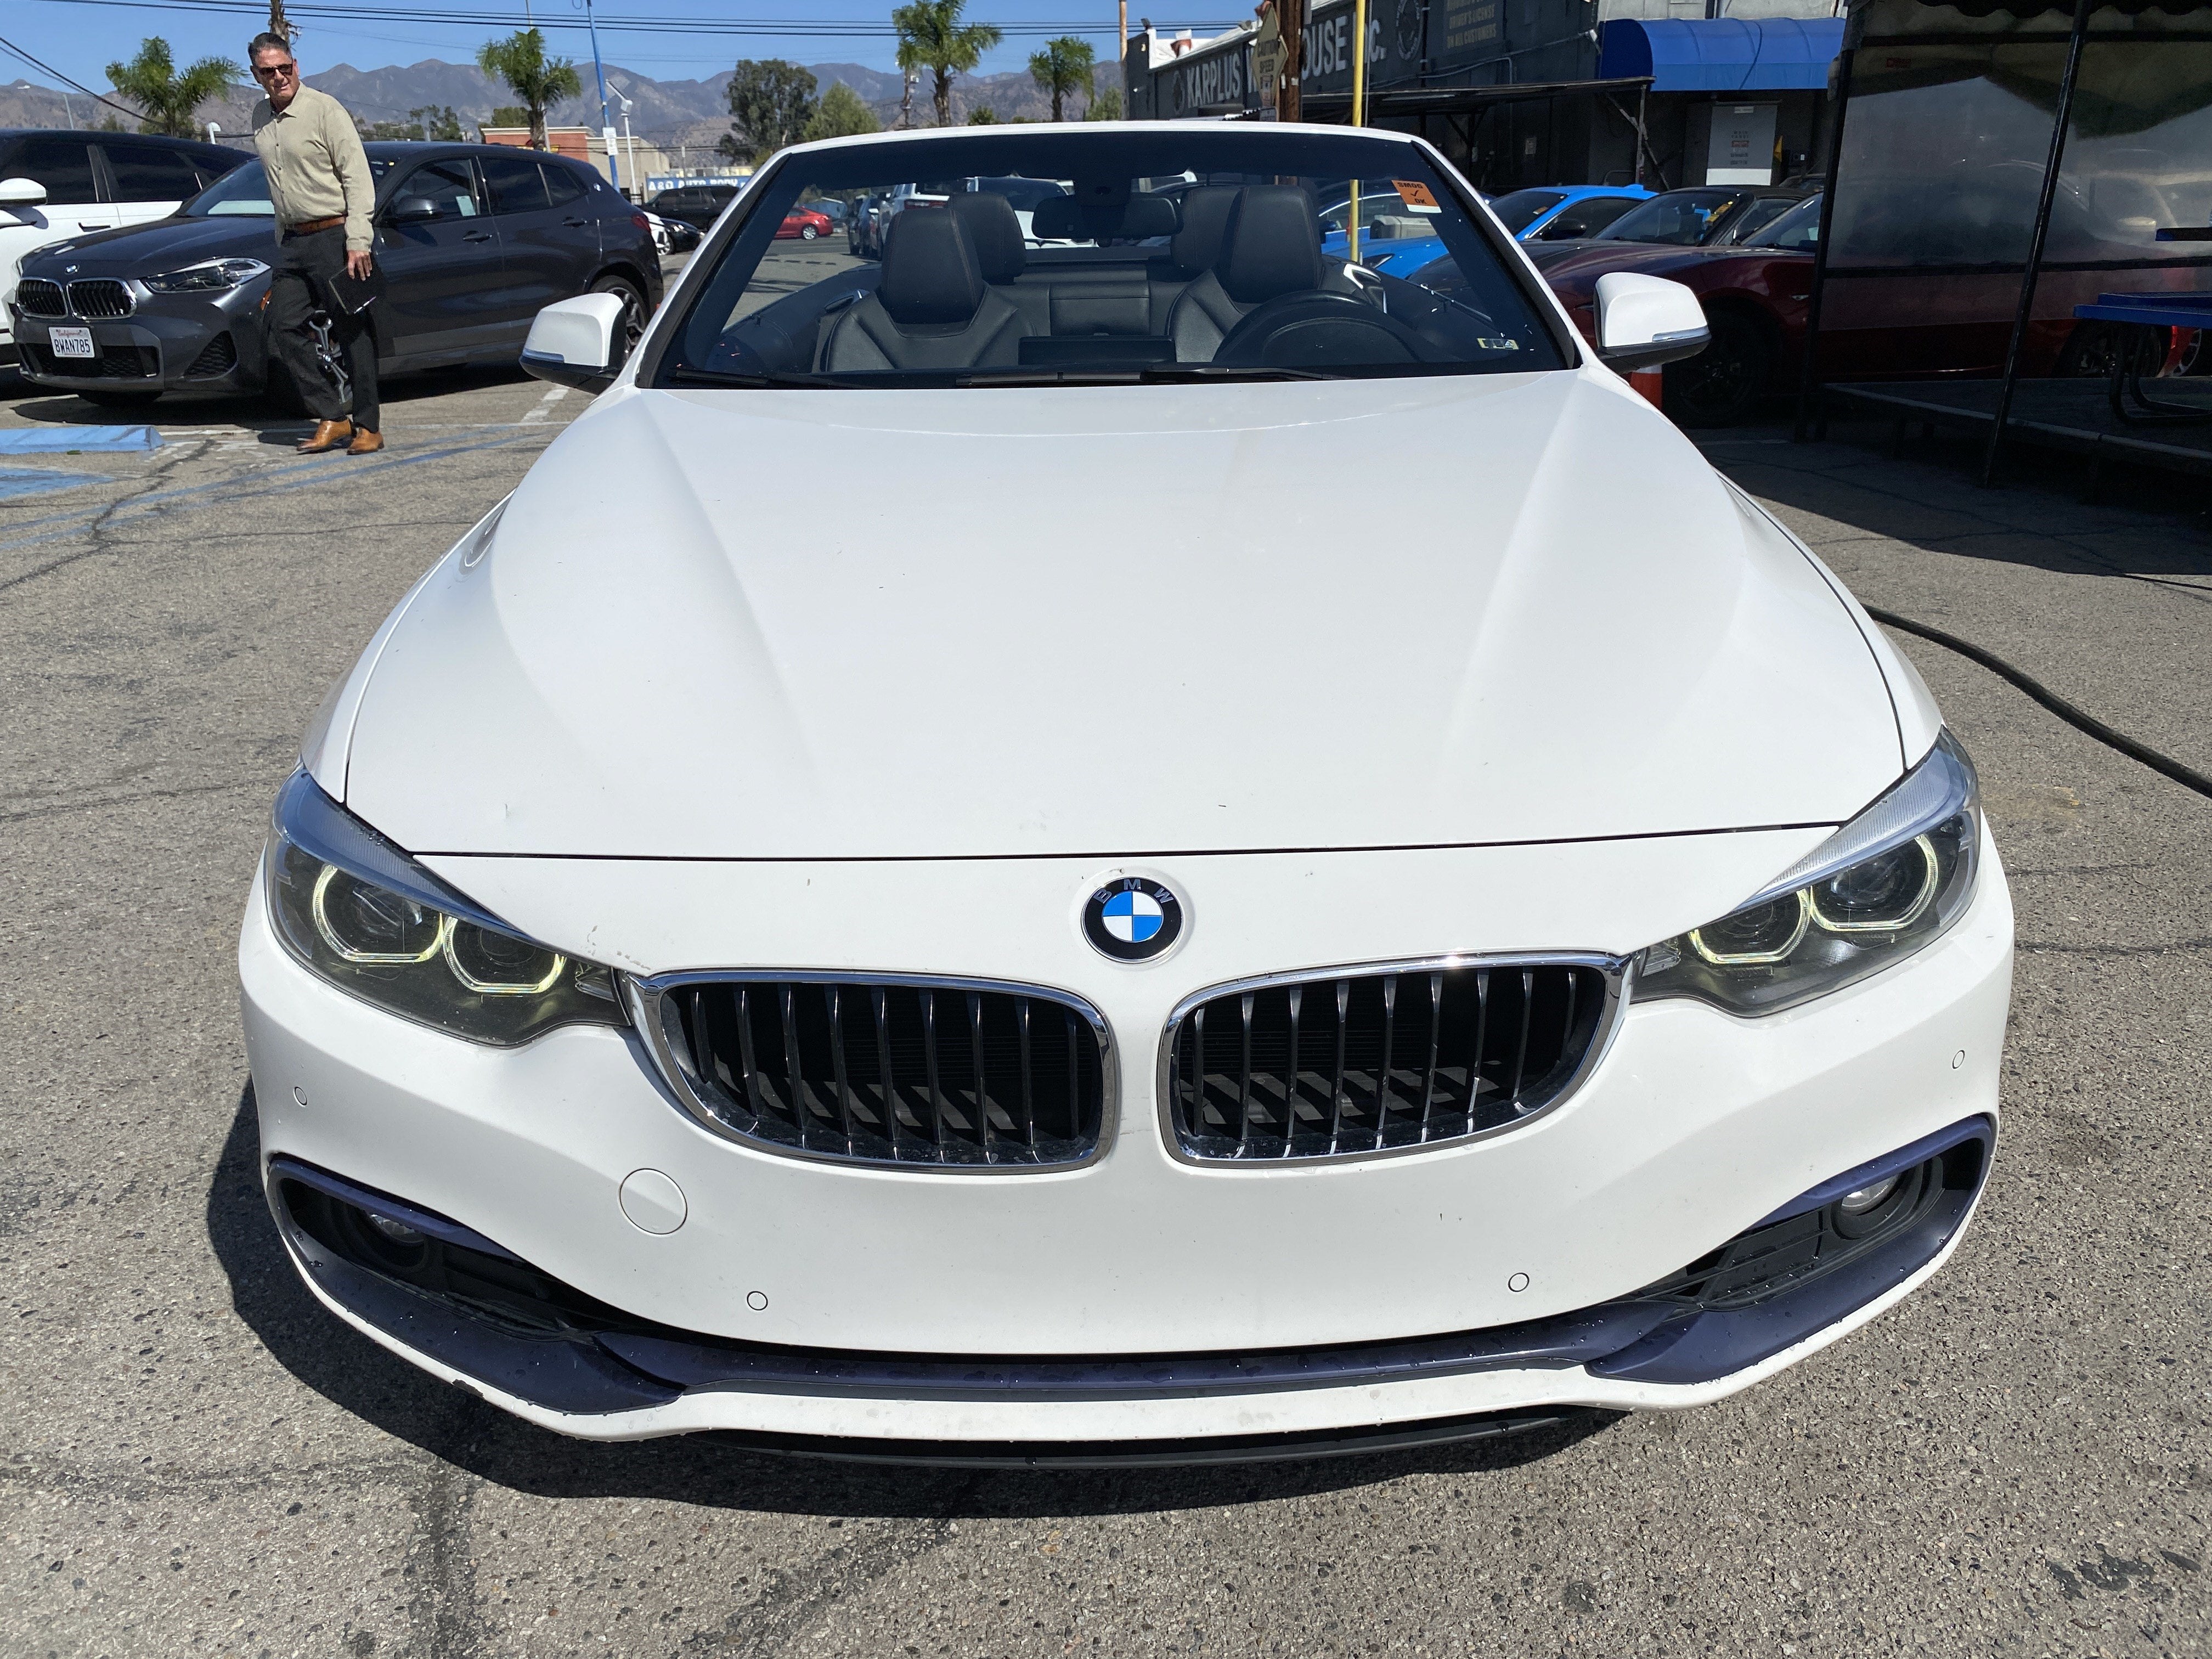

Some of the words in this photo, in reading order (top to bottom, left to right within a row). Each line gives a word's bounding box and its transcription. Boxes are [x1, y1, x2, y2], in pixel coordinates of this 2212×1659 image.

[1187, 52, 1241, 109] KARPLUS
[678, 179, 706, 188] AUTO
[1093, 878, 1174, 904] BMW
